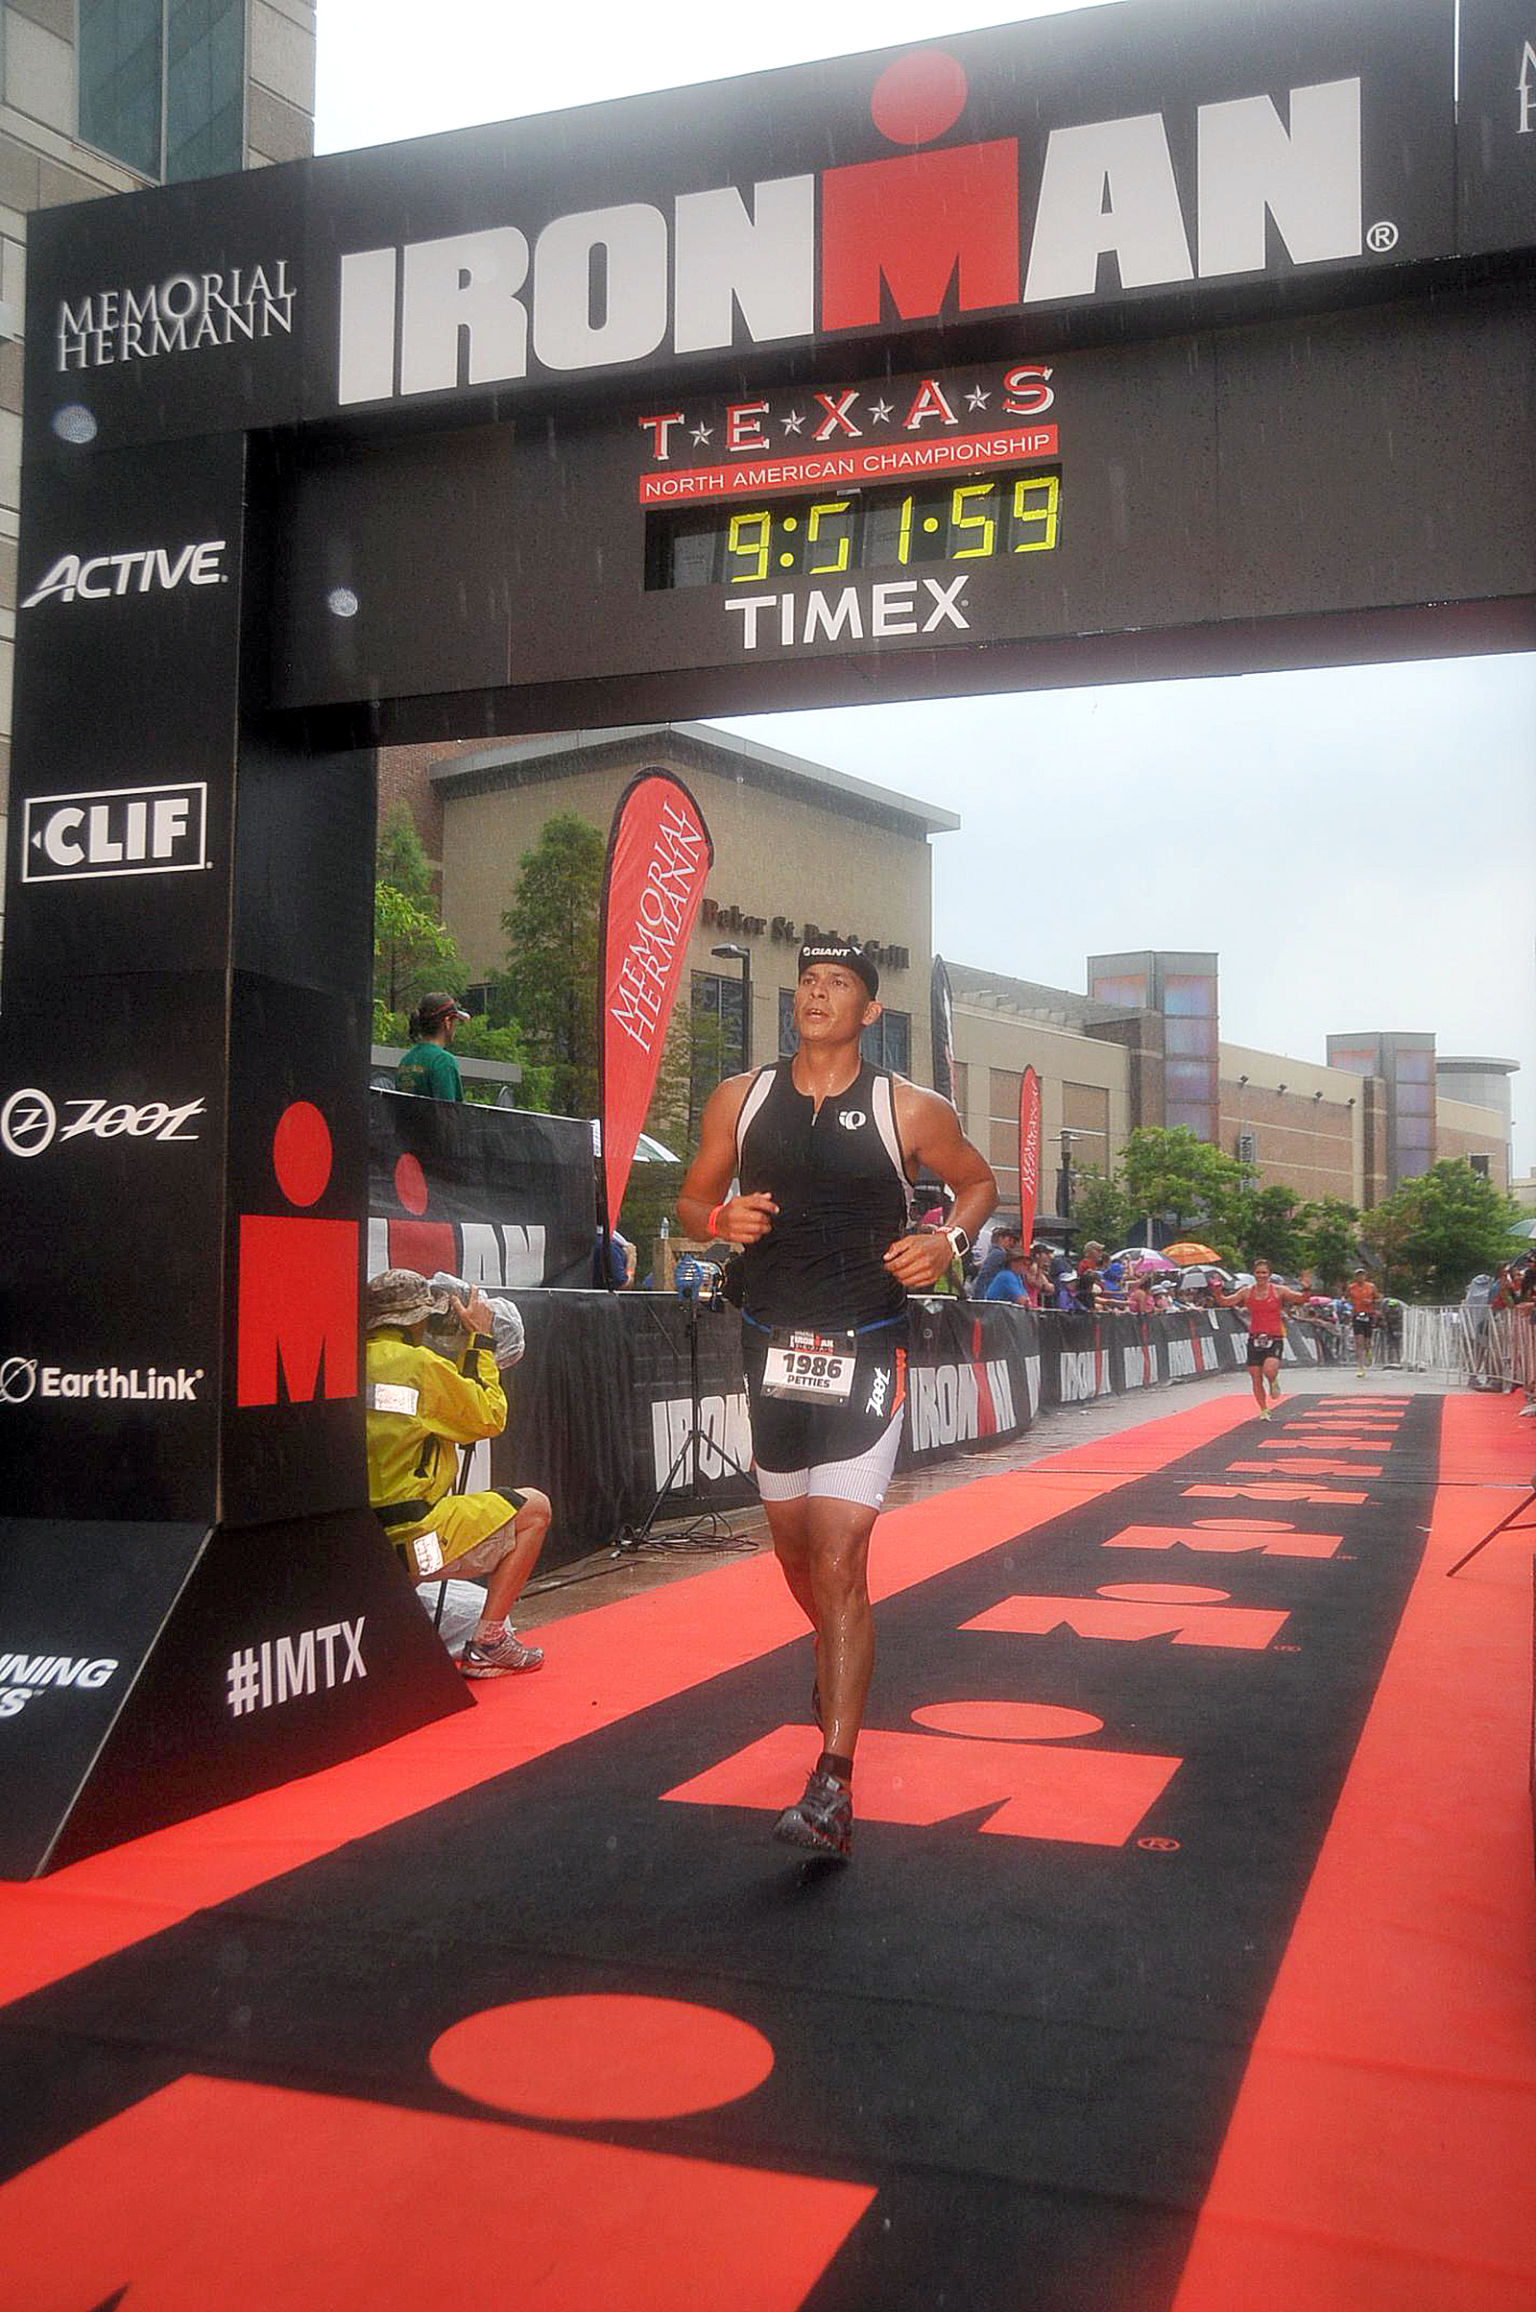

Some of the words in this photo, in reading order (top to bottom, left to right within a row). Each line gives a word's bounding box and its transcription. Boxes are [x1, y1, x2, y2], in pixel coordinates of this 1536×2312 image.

[338, 50, 1362, 405] IRONMAN
[56, 260, 297, 336] MEMORIAL
[57, 295, 293, 372] HERMANN
[645, 475, 725, 498] NORTH
[732, 458, 855, 488] AMERICAN
[862, 433, 1051, 471] CHAMPIONSHIP
[20, 540, 228, 609] ACTIVE
[725, 574, 971, 650] TIMEX
[44, 797, 190, 866] CLIF
[610, 801, 687, 1036] MEMORIAL
[632, 816, 703, 1055] HERMANN
[811, 947, 851, 957] GIANT
[41, 1367, 199, 1401] EarthLink
[782, 1352, 843, 1380] 1986
[226, 1616, 368, 1718] #IMTX
